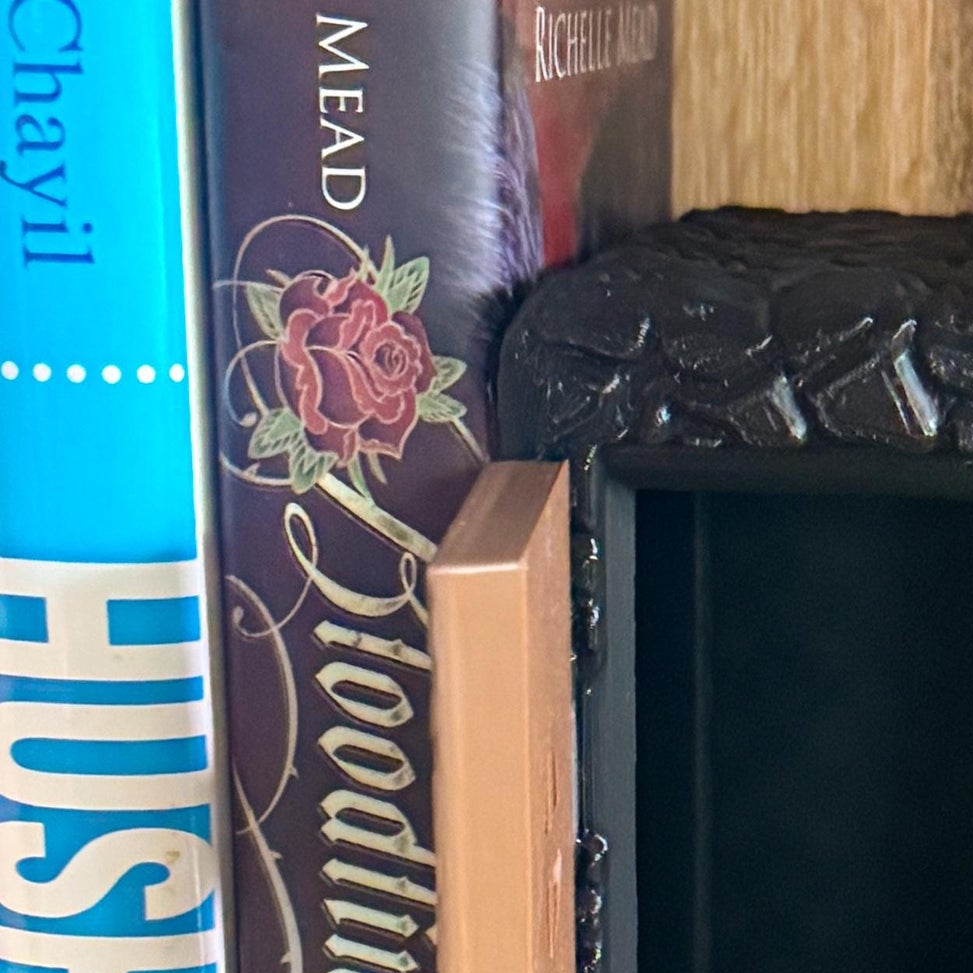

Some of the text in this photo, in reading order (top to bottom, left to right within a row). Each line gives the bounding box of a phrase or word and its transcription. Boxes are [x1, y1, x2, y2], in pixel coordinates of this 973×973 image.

[0, 0, 95, 270] Chayil
[316, 12, 370, 211] MEAD
[535, 5, 612, 83] RICHELLE
